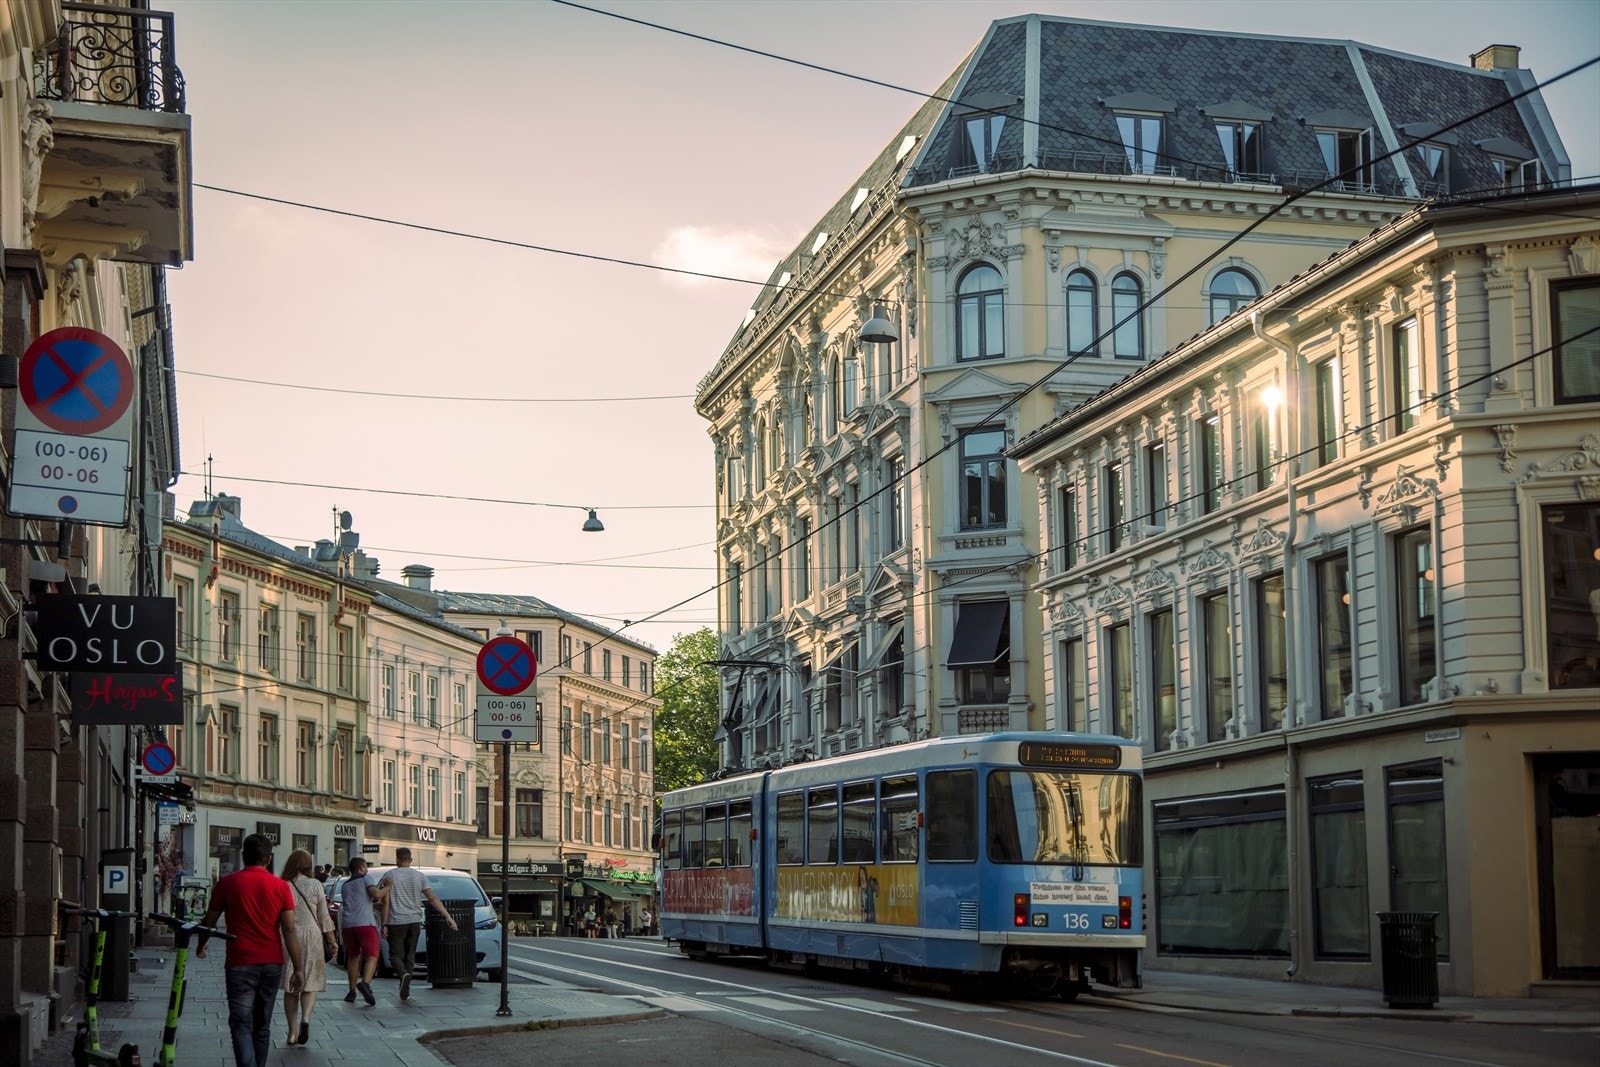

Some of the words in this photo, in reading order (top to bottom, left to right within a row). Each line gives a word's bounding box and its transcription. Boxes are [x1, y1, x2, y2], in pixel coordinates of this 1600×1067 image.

[78, 603, 134, 630] VU
[49, 637, 165, 665] OSLO
[334, 824, 357, 838] GANNI
[417, 827, 438, 842] VOLT
[491, 864, 529, 874] Trfalgar
[530, 864, 548, 874] Pub
[109, 870, 125, 889] P
[778, 872, 816, 904] SUMMER
[896, 884, 914, 899] OSLO
[1063, 913, 1089, 930] 136
